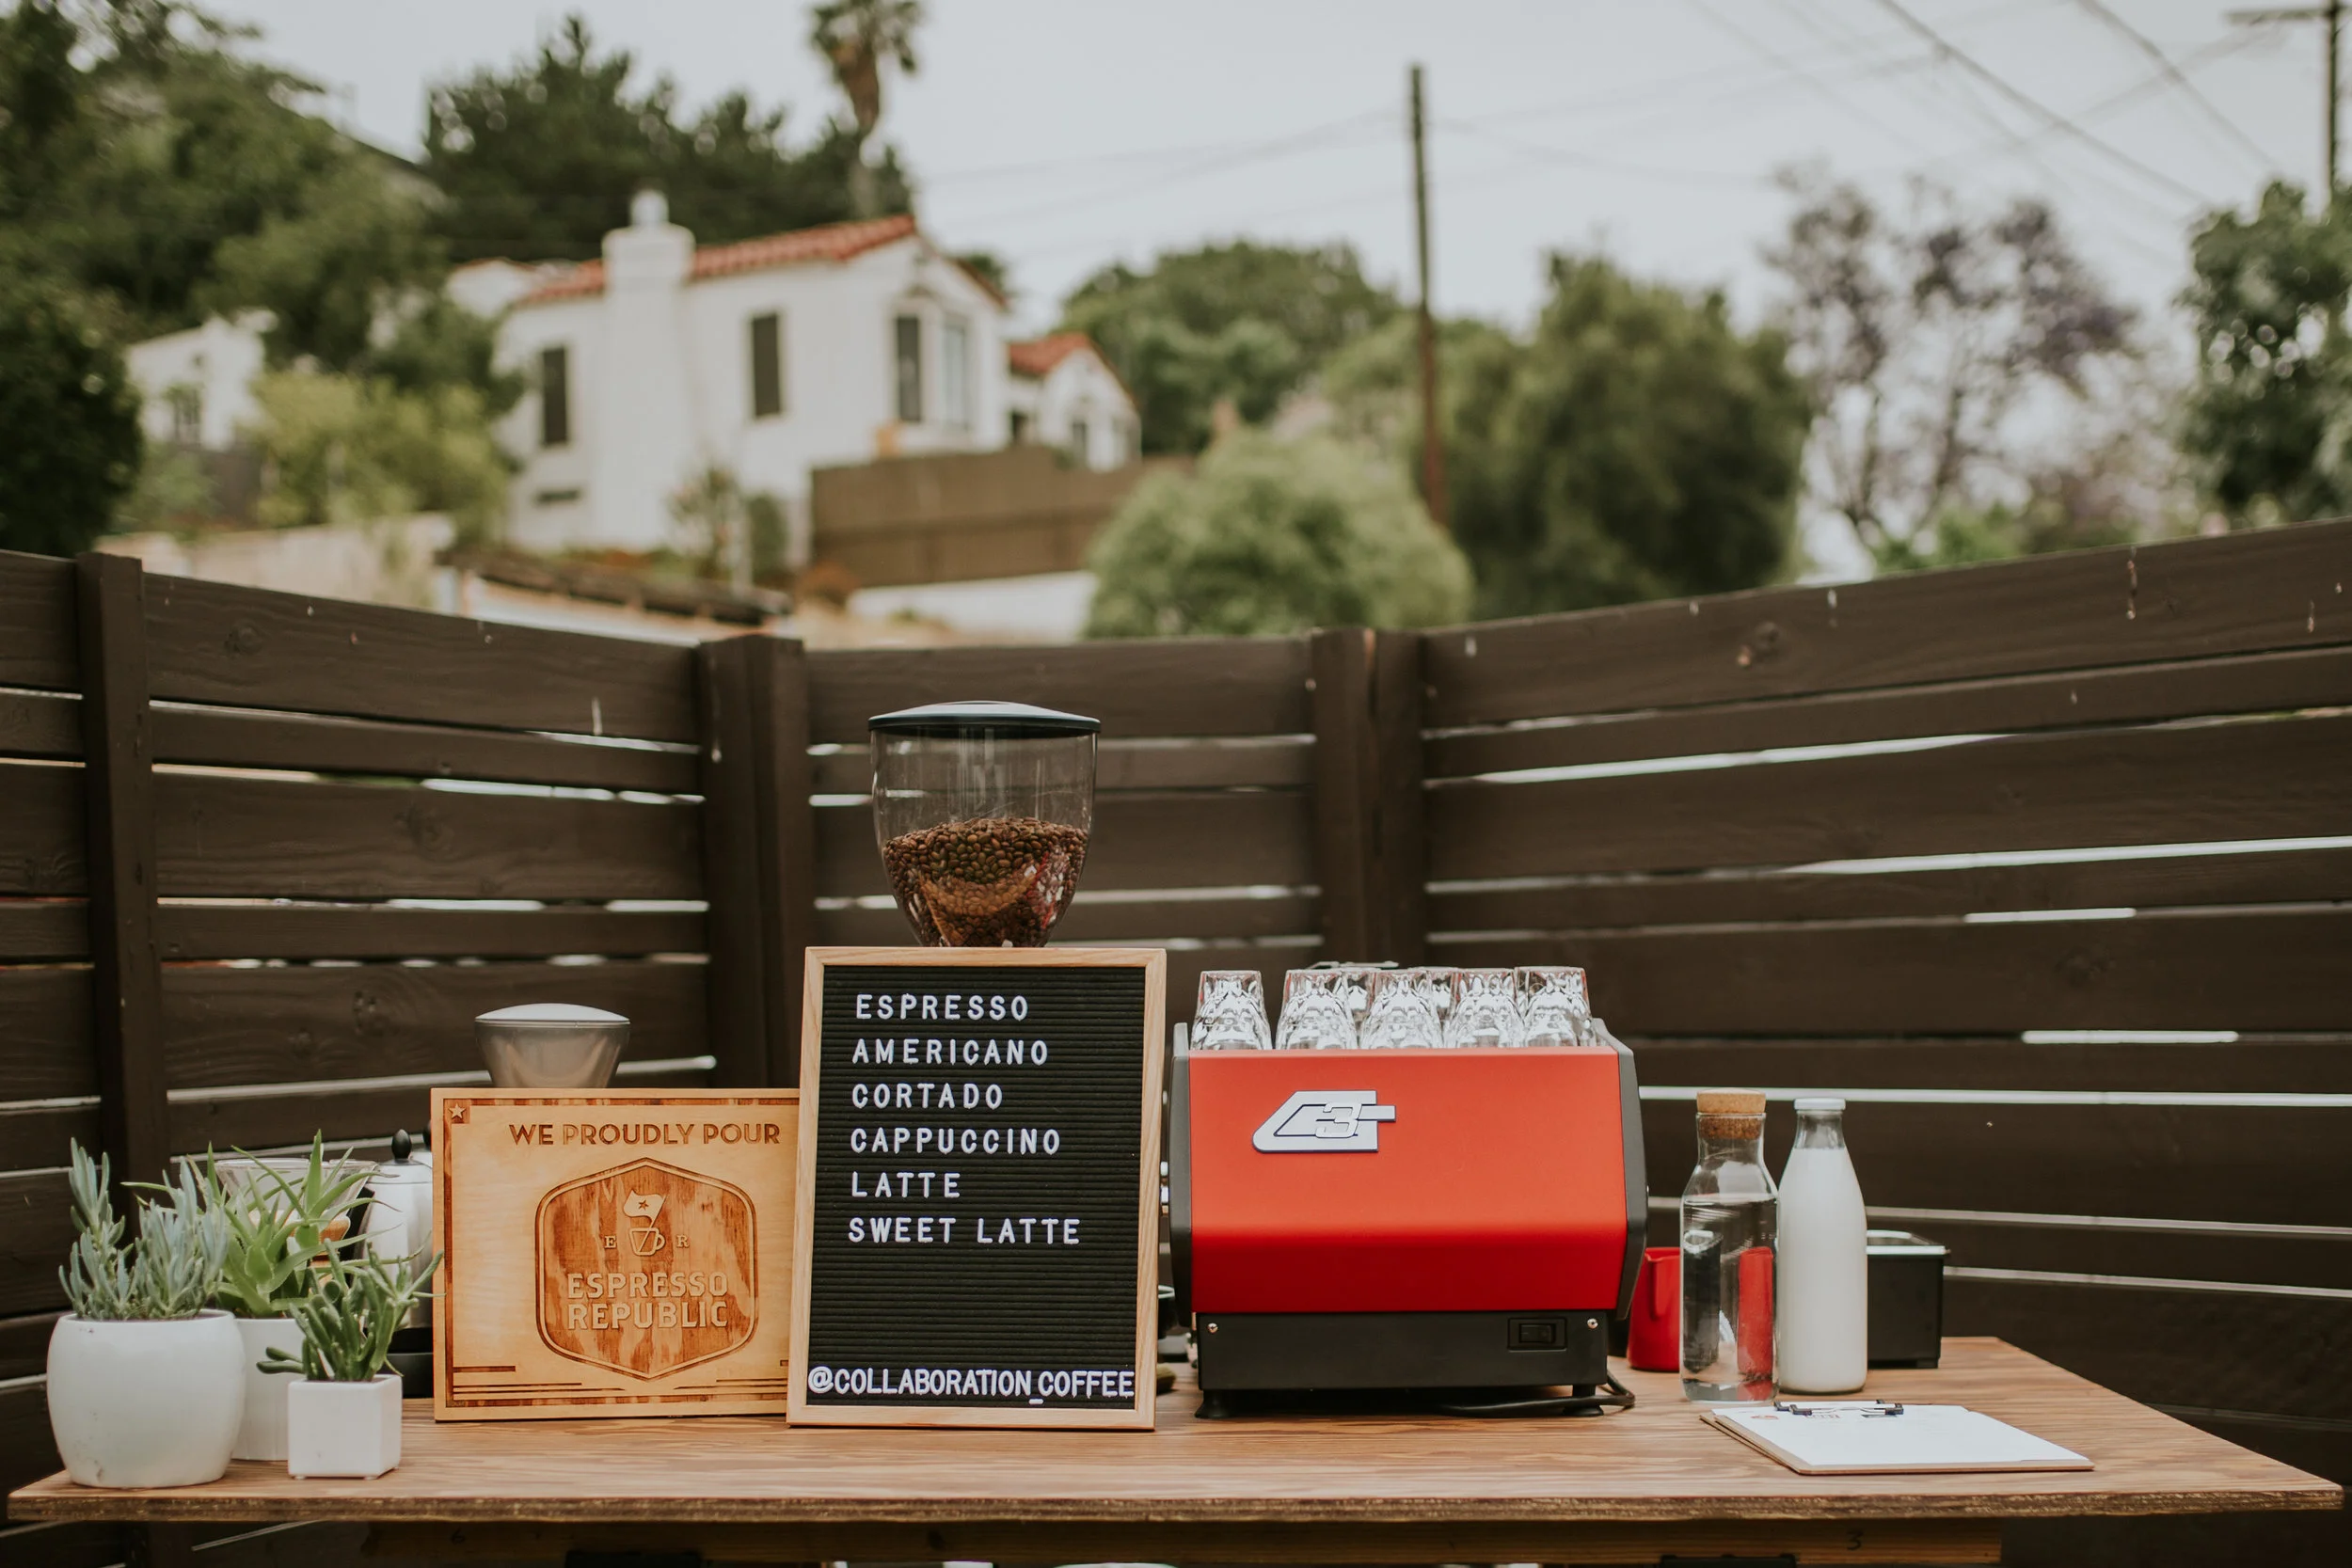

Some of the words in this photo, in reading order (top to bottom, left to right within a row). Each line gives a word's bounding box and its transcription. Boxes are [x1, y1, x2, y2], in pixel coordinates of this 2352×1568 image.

[856, 993, 1029, 1021] ESPRESSO
[851, 1038, 1048, 1066] AMERICANO
[851, 1083, 1003, 1109] CORTADO
[509, 1123, 553, 1145] WE
[562, 1123, 694, 1145] PROUDLY
[703, 1123, 780, 1145] POUR
[850, 1127, 1060, 1154] CAPPUCCINO
[851, 1171, 961, 1197] LATTE
[604, 1235, 617, 1249] E
[676, 1235, 690, 1249] R
[848, 1217, 956, 1243] SWEET
[977, 1218, 1081, 1244] LATTE
[567, 1272, 728, 1298] ESPRESSO
[567, 1301, 728, 1329] REPUBLIC
[807, 1366, 1135, 1405] @COLLABORATION_COFFEE
[1846, 1530, 1864, 1551] 3
